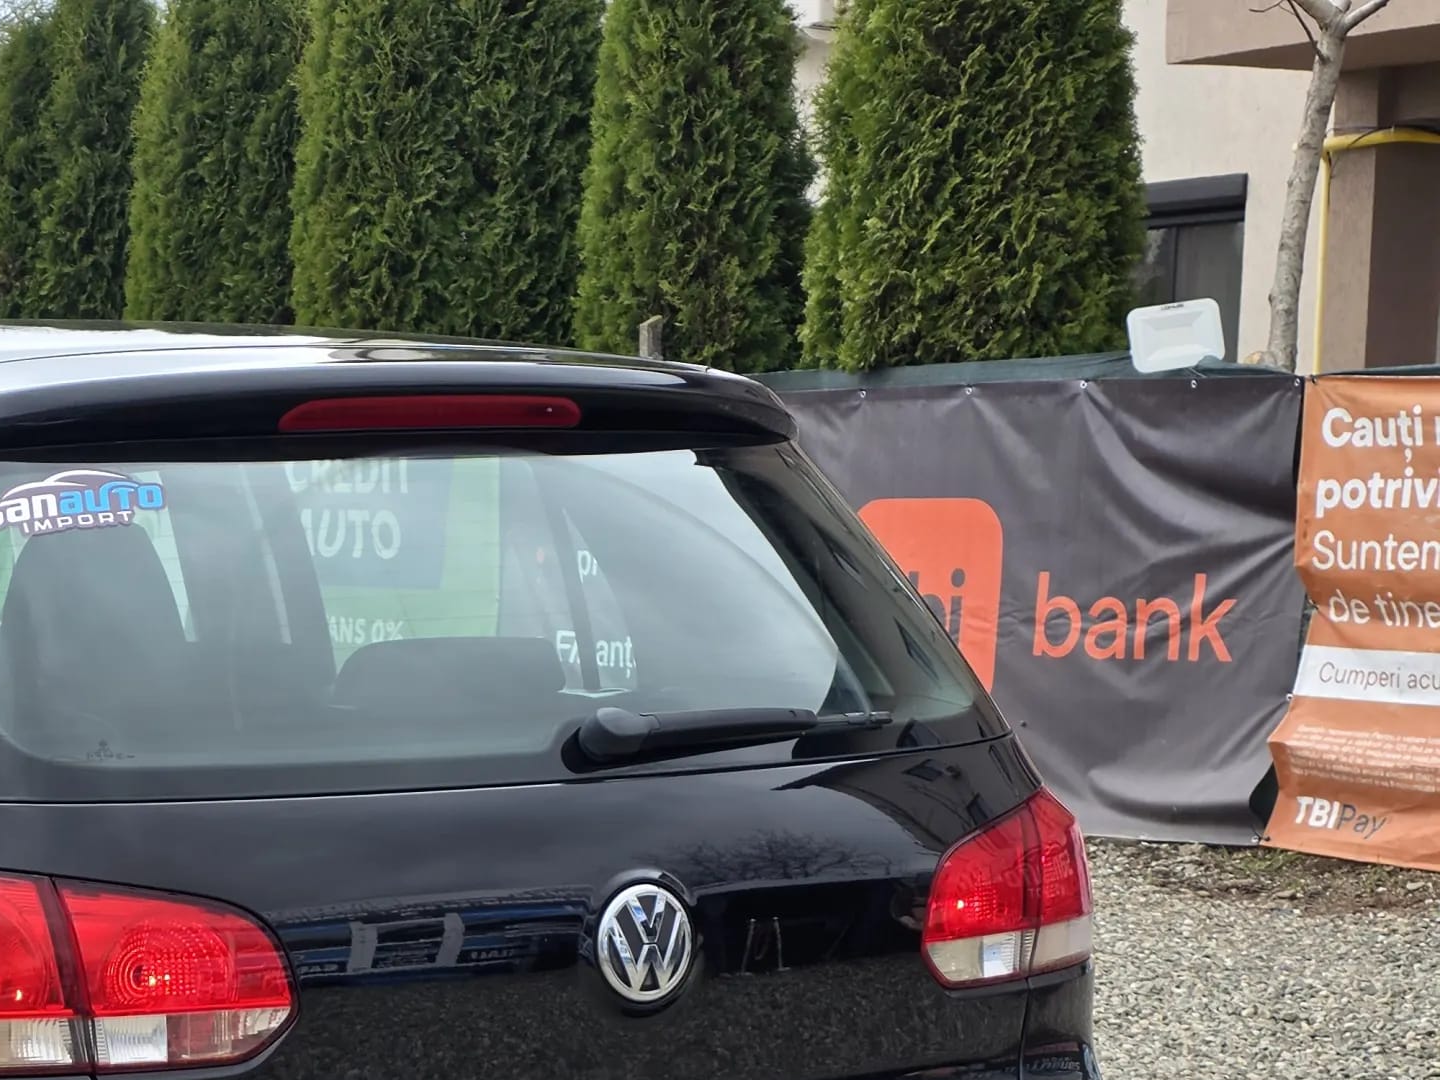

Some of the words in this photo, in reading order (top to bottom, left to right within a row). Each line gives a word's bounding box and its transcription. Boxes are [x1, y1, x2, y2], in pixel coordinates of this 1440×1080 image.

[1321, 404, 1424, 463] Cauți
[1315, 466, 1440, 518] potriv
[22, 511, 133, 534] IMPORT
[1032, 571, 1238, 662] bank
[1328, 589, 1371, 625] de
[1319, 662, 1401, 690] Cumperi
